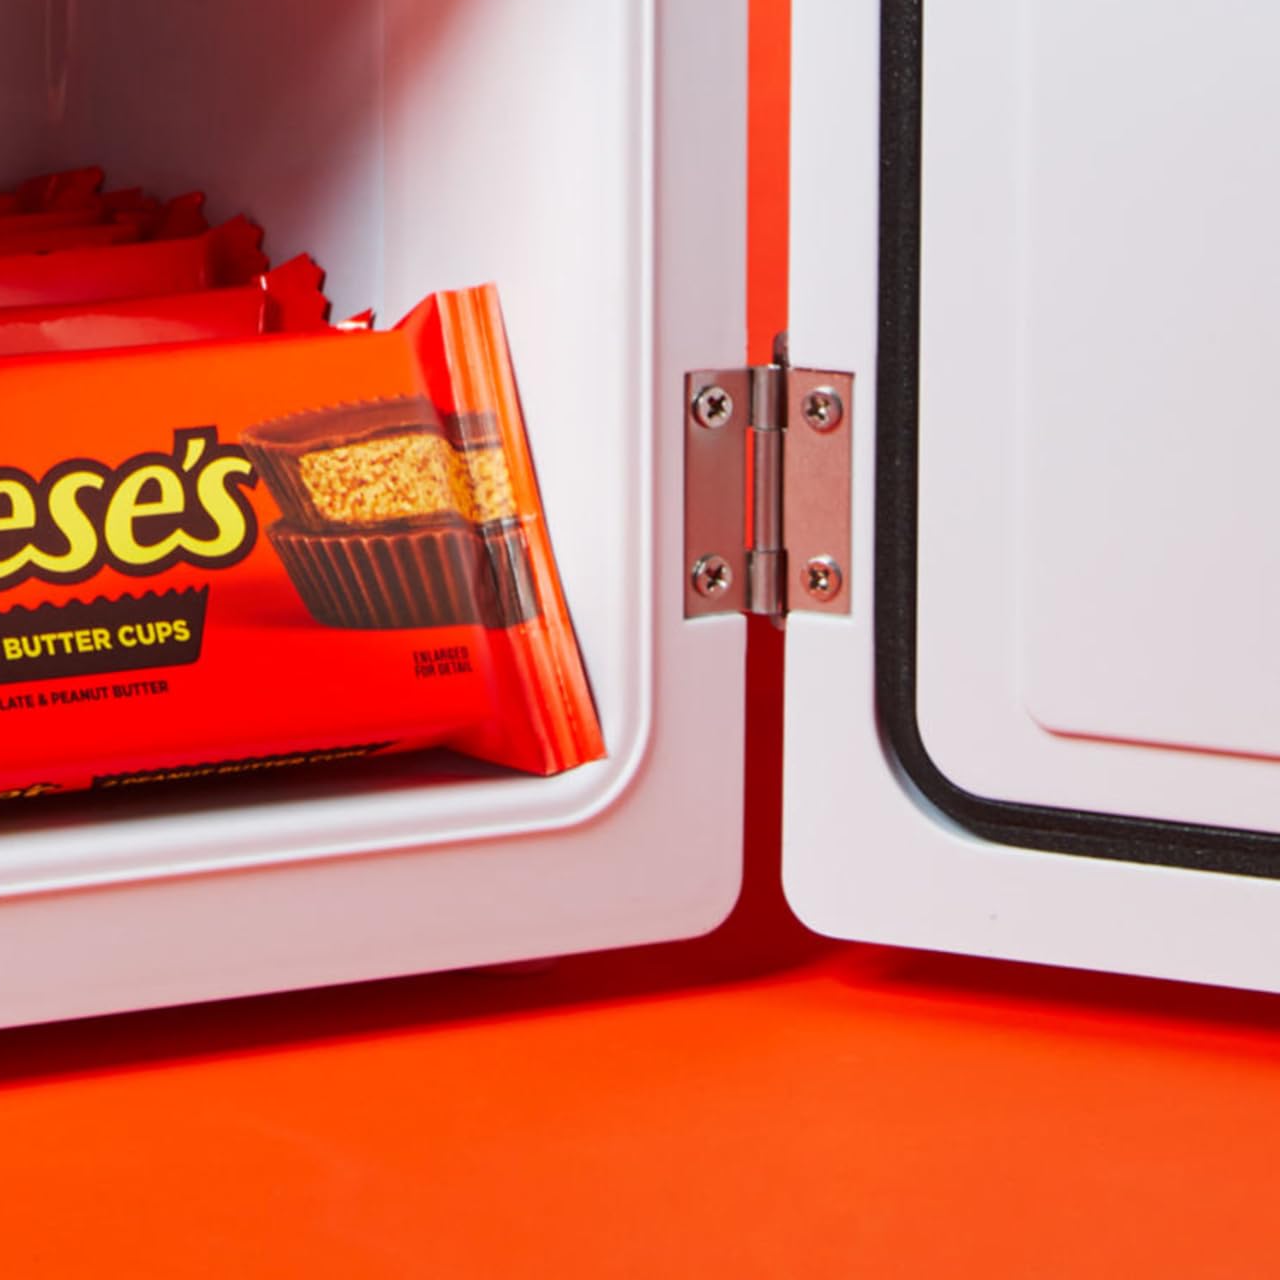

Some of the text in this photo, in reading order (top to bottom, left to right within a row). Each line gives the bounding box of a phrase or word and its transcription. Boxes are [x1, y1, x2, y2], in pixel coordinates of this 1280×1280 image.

[3, 627, 113, 660] BUTTER
[117, 619, 191, 648] CUPS
[36, 692, 48, 707] &
[51, 683, 110, 705] PEANUT
[112, 680, 170, 700] BUTTER
